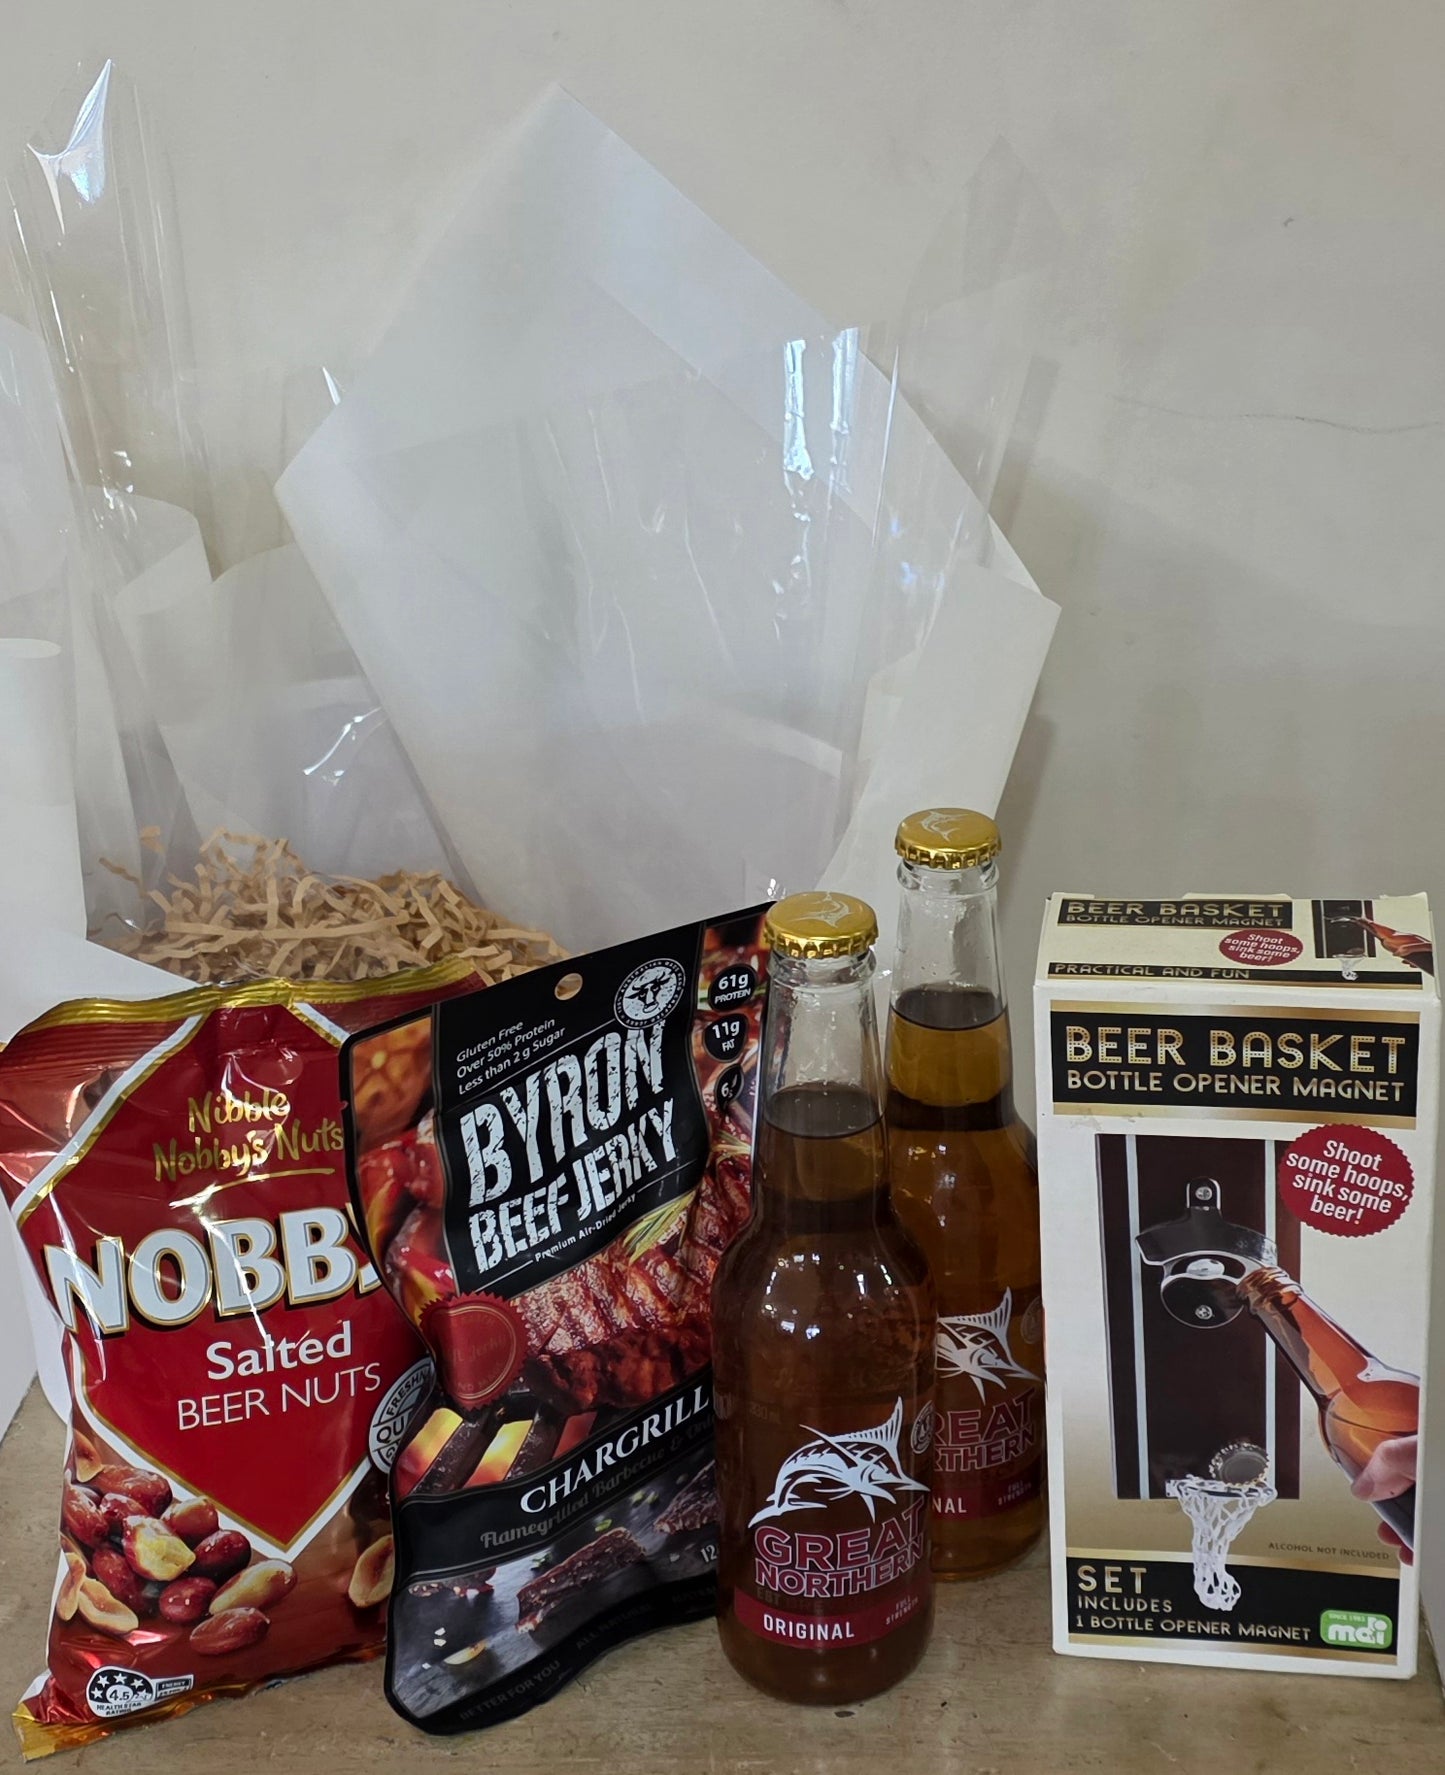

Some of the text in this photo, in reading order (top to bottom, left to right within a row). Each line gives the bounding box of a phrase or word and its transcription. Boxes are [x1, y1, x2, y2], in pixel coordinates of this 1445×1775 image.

[1066, 914, 1283, 926] BOTTLE OPENER MAGNET
[1067, 902, 1283, 917] BEER BASKET
[1224, 937, 1300, 954] some hoops,
[1228, 943, 1290, 958] sink some
[1247, 933, 1283, 944] Shoot
[1055, 964, 1249, 979] PRACTICAL AND FUN
[1239, 951, 1273, 963] beer!
[714, 988, 751, 1004] PROTEIN
[718, 973, 749, 990] 61g
[456, 1021, 524, 1062] Gluten Free
[712, 1020, 740, 1039] 11g
[456, 1019, 555, 1078] Over 50% Protein
[721, 1038, 735, 1052] FAT
[1065, 1025, 1406, 1074] BEER BASKET
[458, 1075, 484, 1095] Less
[485, 1058, 511, 1080] than
[532, 1027, 565, 1052] Sugar
[1067, 1069, 1405, 1101] BOTTLE OPENER MAGNET
[187, 1088, 291, 1134] Nibble
[460, 1019, 667, 1208] BYRON
[152, 1117, 344, 1182] Nobby's Nuts
[1323, 1139, 1383, 1171] Shoot
[469, 1097, 678, 1274] BEEF JERKY
[1286, 1152, 1409, 1201] some hoops,
[1292, 1172, 1392, 1214] sink some
[1309, 1195, 1364, 1225] beer!
[534, 1235, 577, 1262] Premium
[43, 1203, 381, 1335] NOBB
[206, 1320, 352, 1381] Salted
[178, 1362, 381, 1431] BEER NUTS
[519, 1385, 710, 1514] CHARGRILL
[754, 1495, 925, 1572] GREAT
[700, 1544, 719, 1563] 12
[755, 1532, 924, 1598] NORTHERN
[1268, 1542, 1390, 1560] ALCOHOL NOT INCLUDED
[1077, 1564, 1148, 1594] SET
[1077, 1596, 1173, 1613] INCLUDES
[763, 1613, 855, 1641] ORIGINAL
[1076, 1615, 1311, 1641] 1 BOTTLE OPENER MAGNET
[109, 1689, 130, 1701] 4.5
